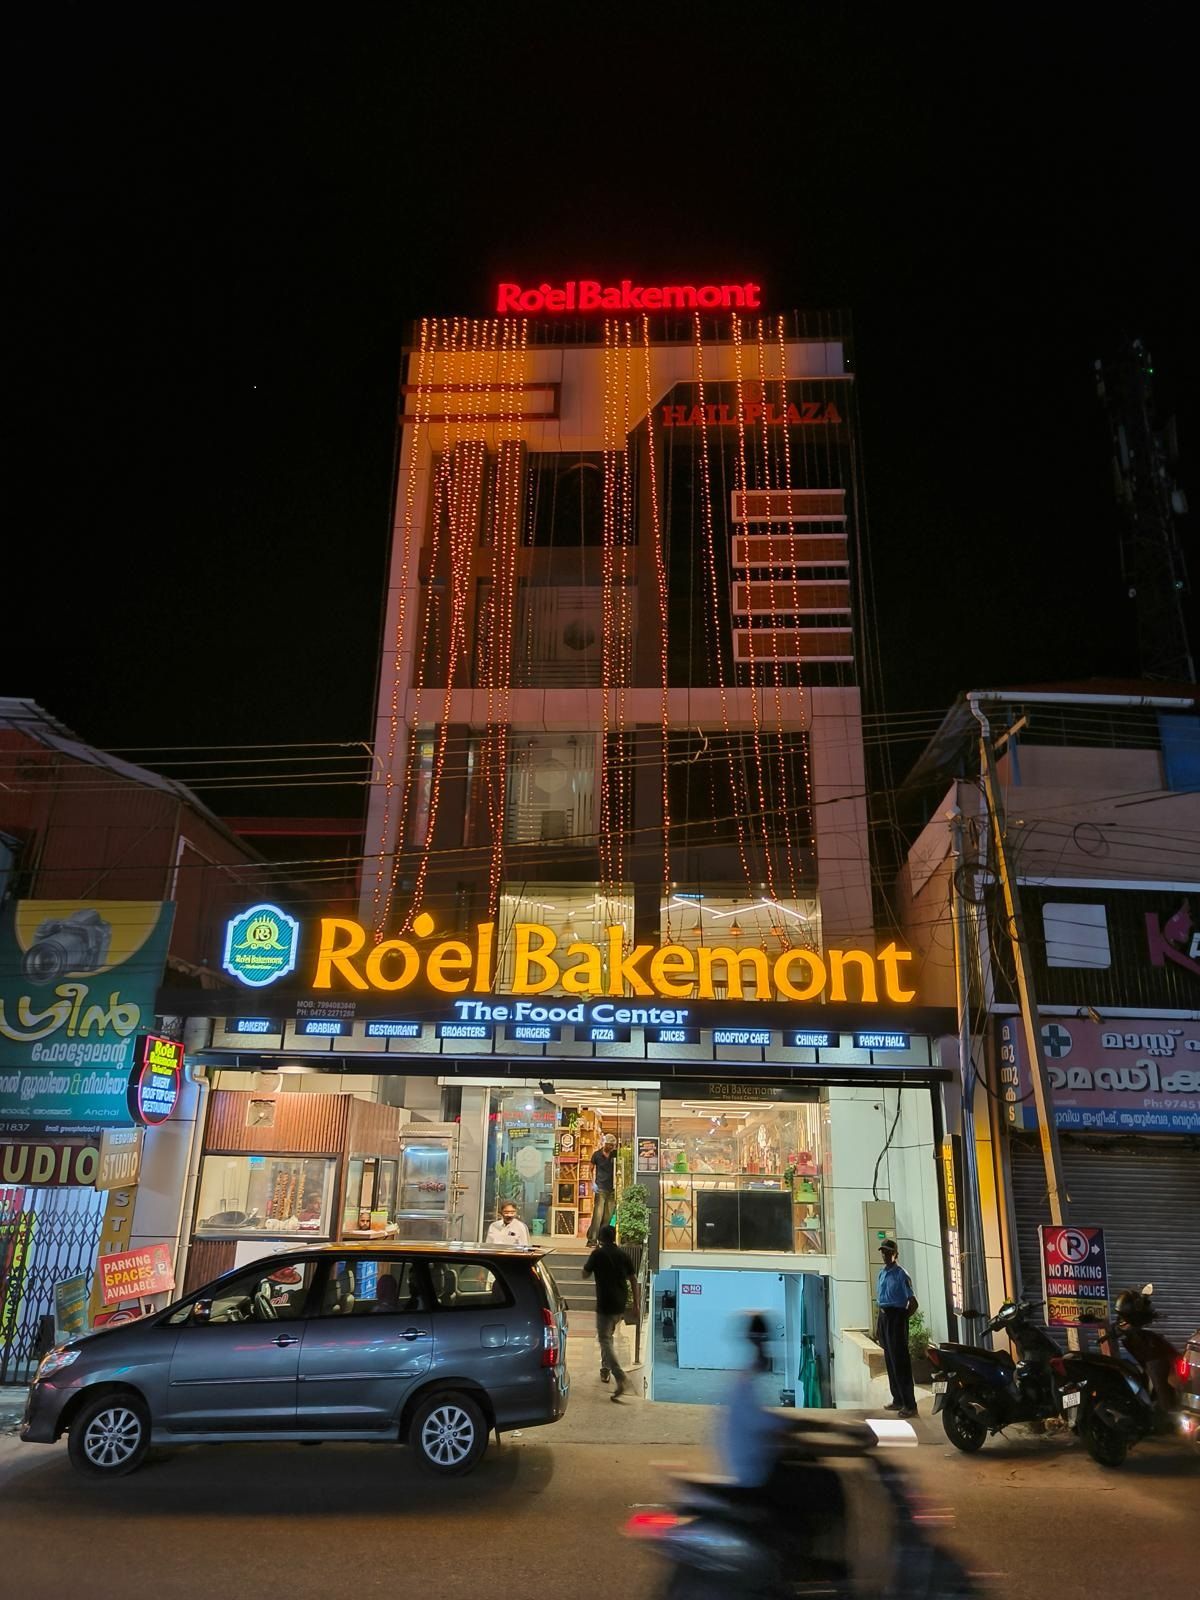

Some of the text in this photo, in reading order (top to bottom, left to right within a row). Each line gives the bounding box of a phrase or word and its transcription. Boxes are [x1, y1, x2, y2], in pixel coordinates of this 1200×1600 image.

[662, 402, 842, 427] HAIL PLAZA
[510, 923, 918, 1003] Bakemont
[455, 1001, 688, 1025] The Food Center
[238, 1021, 269, 1032] BAKERY
[306, 1022, 341, 1034] ARABIAN
[368, 1024, 419, 1036] RESTAURANT
[441, 1025, 486, 1038] BROASTERS
[515, 1027, 550, 1039] BURGERS
[591, 1028, 614, 1040] PIZZA
[659, 1030, 685, 1042] JUICES
[750, 1032, 770, 1044] CAFE
[796, 1034, 828, 1046] CHINESE
[859, 1035, 905, 1047] PARTY HALL
[84, 1108, 120, 1116] Anchal
[102, 1151, 138, 1182] STUDIO
[104, 1254, 151, 1274] PARKING
[105, 1266, 152, 1287] SPACES
[1048, 1263, 1102, 1279] NO PARKING
[106, 1278, 157, 1299] AVAILABLE
[1047, 1283, 1106, 1297] ANCHAL POLICE
